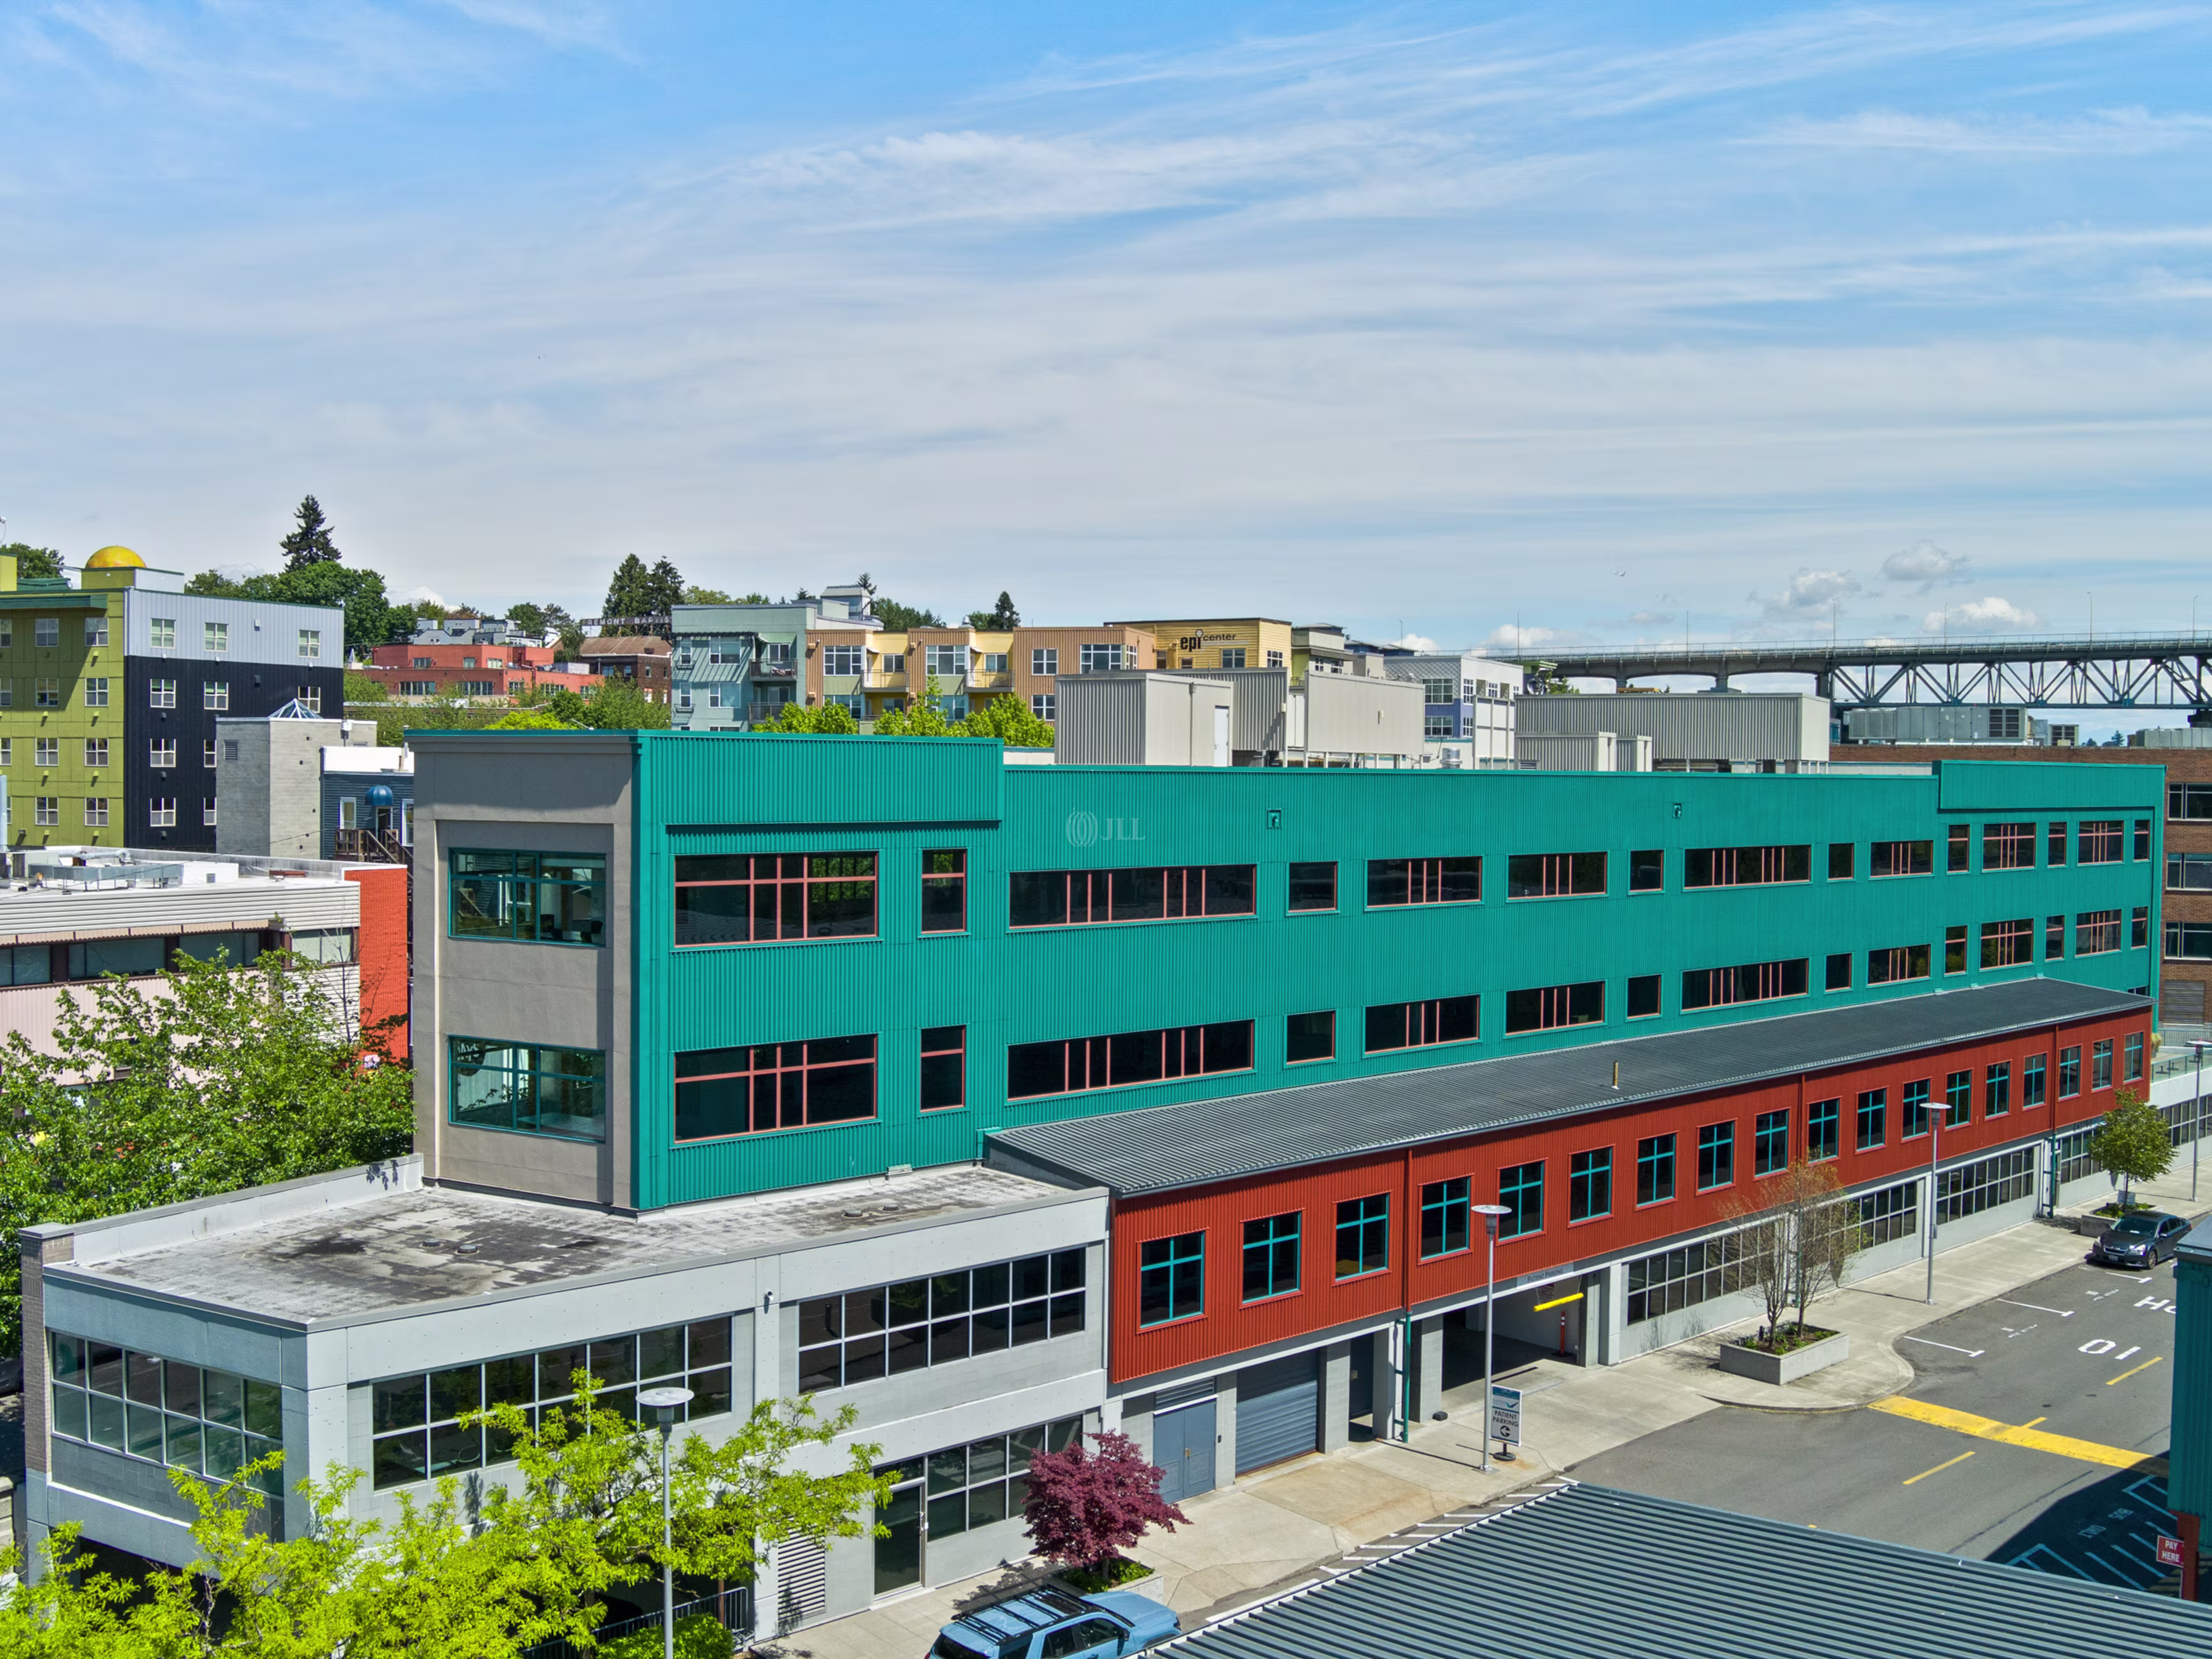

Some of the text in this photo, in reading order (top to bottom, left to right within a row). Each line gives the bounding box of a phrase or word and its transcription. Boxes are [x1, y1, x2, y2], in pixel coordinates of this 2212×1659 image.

[1494, 1410, 1517, 1420] PATIENT
[1493, 1416, 1518, 1427] PARKING
[2165, 1540, 2178, 1551] PAY
[2162, 1550, 2180, 1562] HERE
